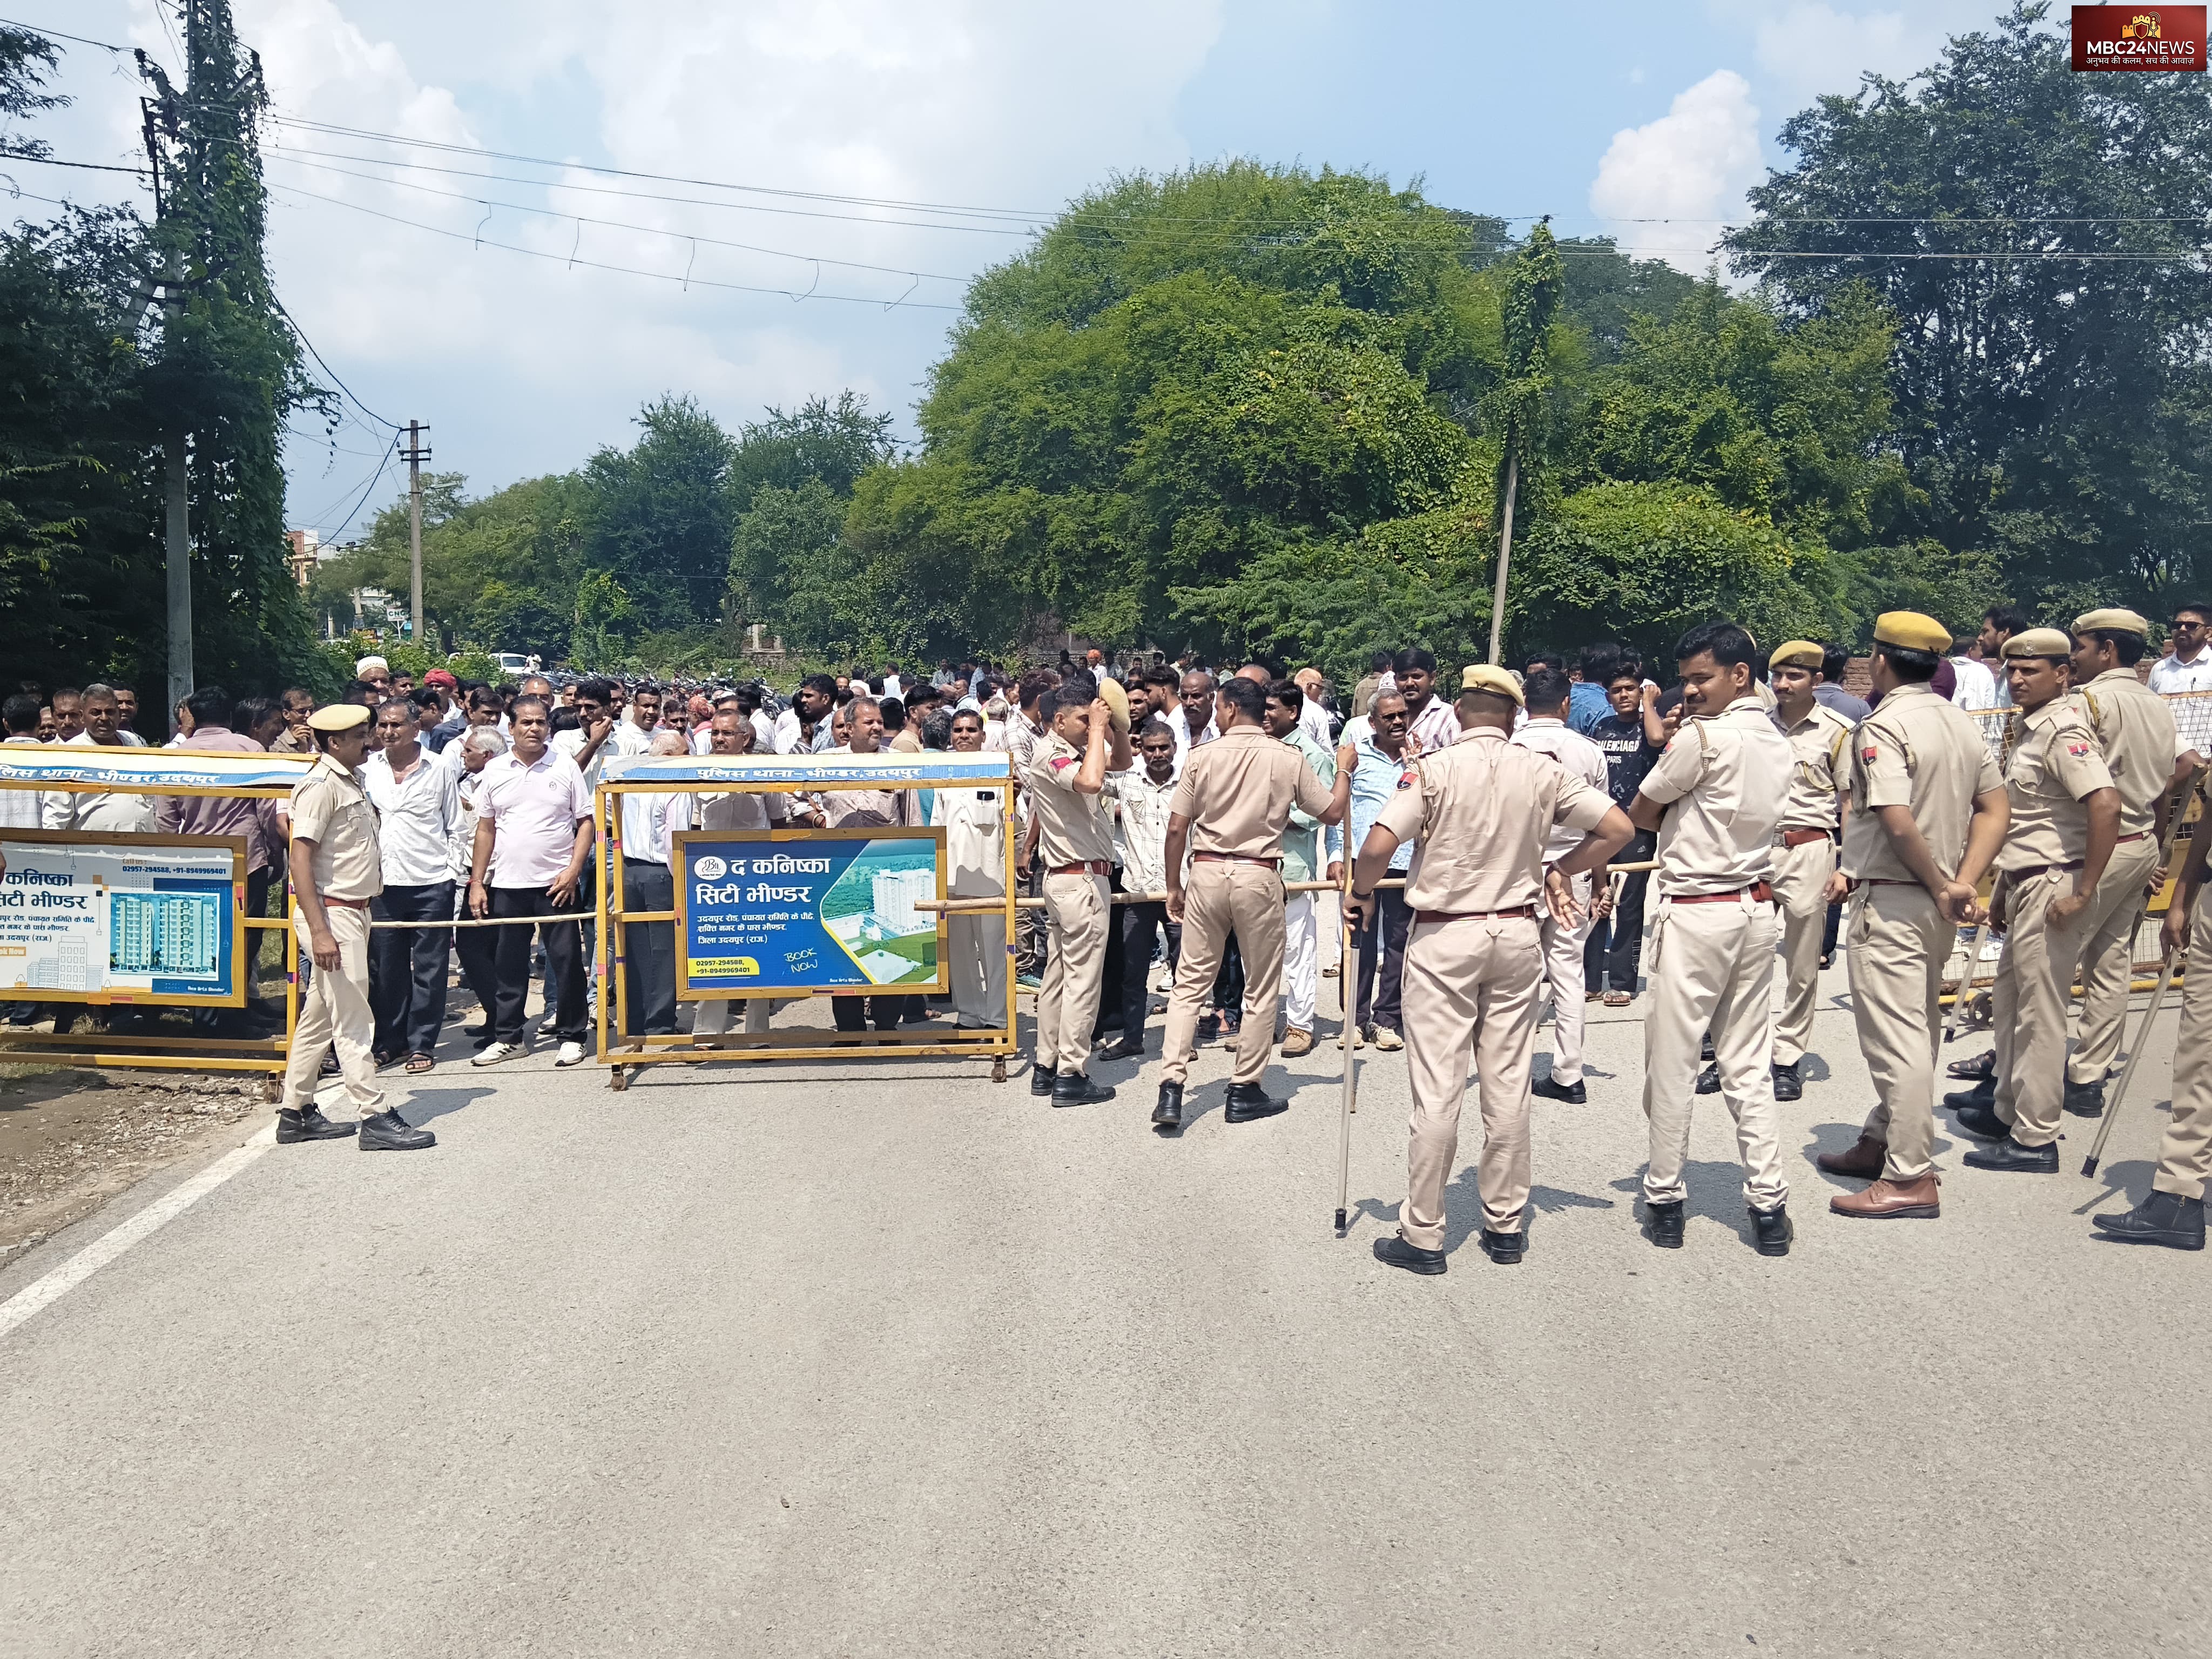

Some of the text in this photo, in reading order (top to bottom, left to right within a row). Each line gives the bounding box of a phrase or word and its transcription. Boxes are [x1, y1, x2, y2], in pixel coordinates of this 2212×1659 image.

[1607, 755, 1622, 764] PARIS
[0, 764, 37, 778] लिस
[696, 767, 748, 779] पुलिस
[731, 854, 831, 875] द कनिष्का
[5, 868, 73, 886] कनिष्का
[31, 891, 88, 909] भीण्डर
[696, 882, 812, 905] सिटी भीण्डर
[698, 936, 716, 944] जिला
[784, 947, 817, 962] BOOK
[791, 959, 818, 973] NOW
